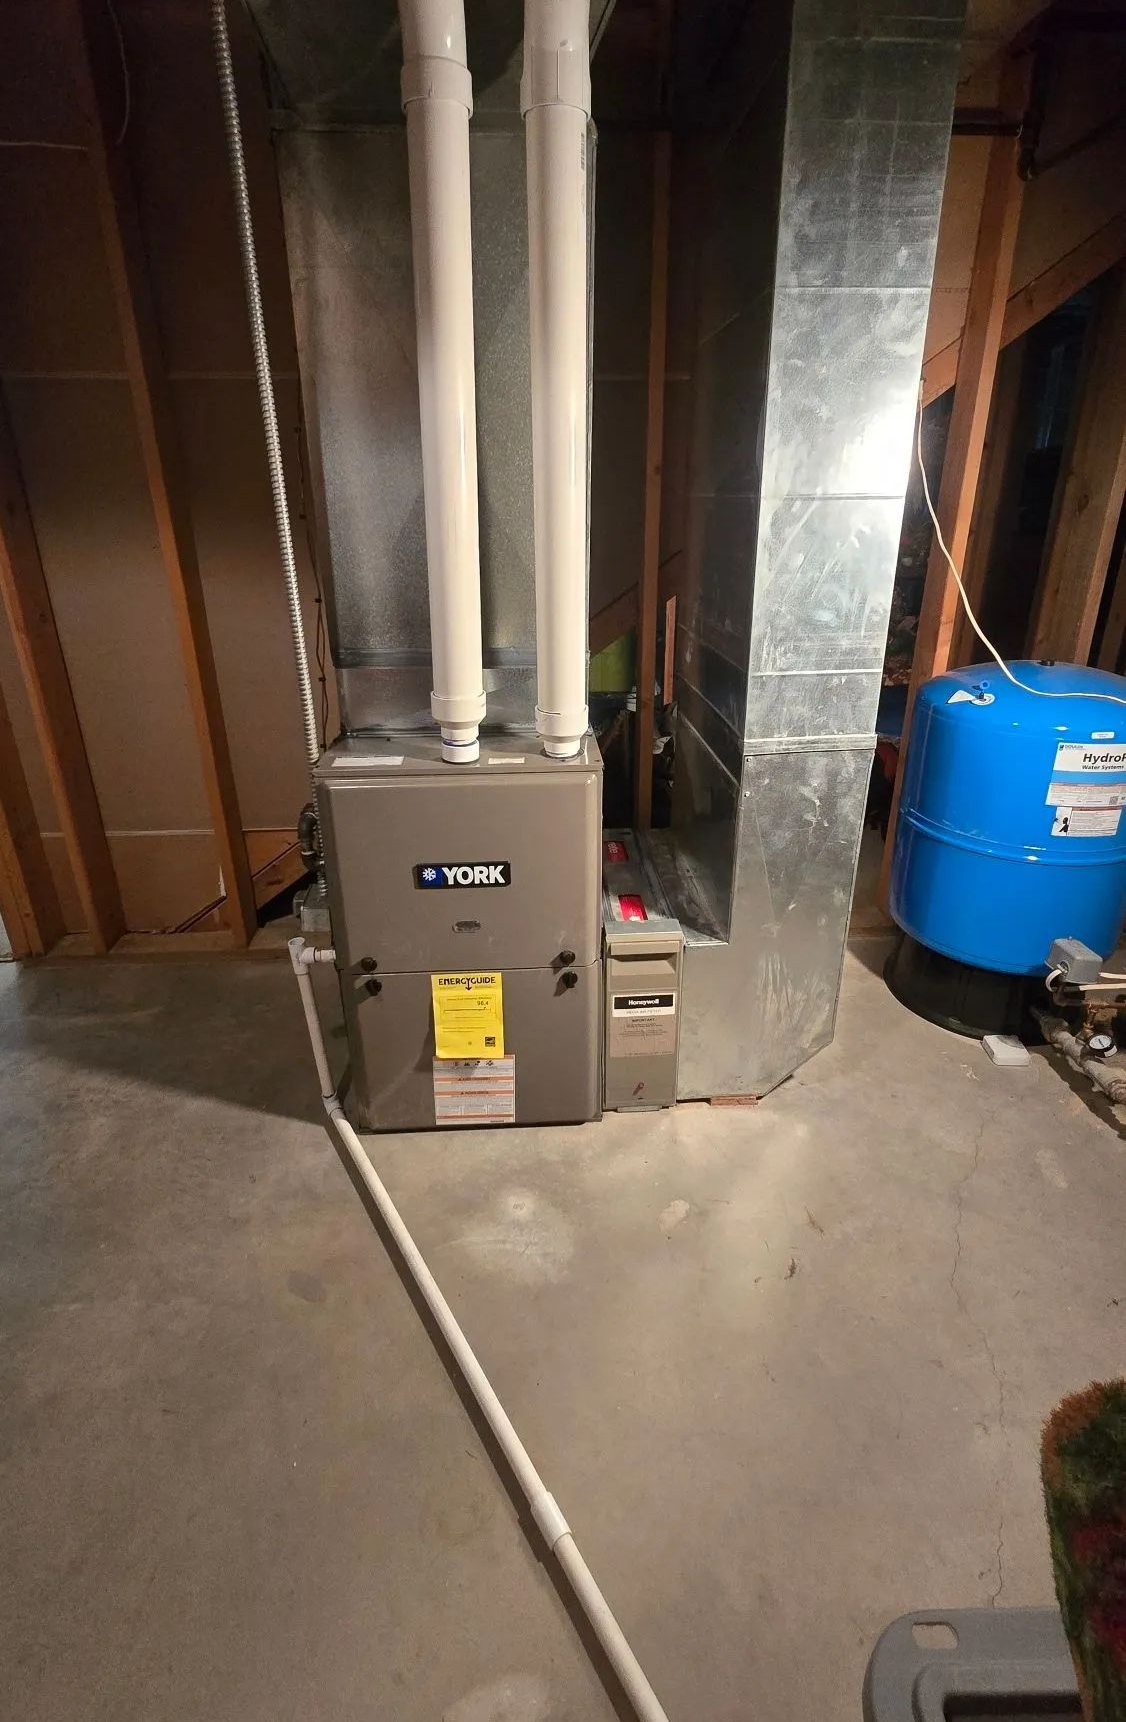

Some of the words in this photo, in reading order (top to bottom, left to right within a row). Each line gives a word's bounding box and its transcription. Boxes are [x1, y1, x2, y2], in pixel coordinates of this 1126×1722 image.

[442, 865, 505, 885] YORK
[438, 976, 496, 987] ENERGYGUIDE
[628, 998, 660, 1006] Honeywell
